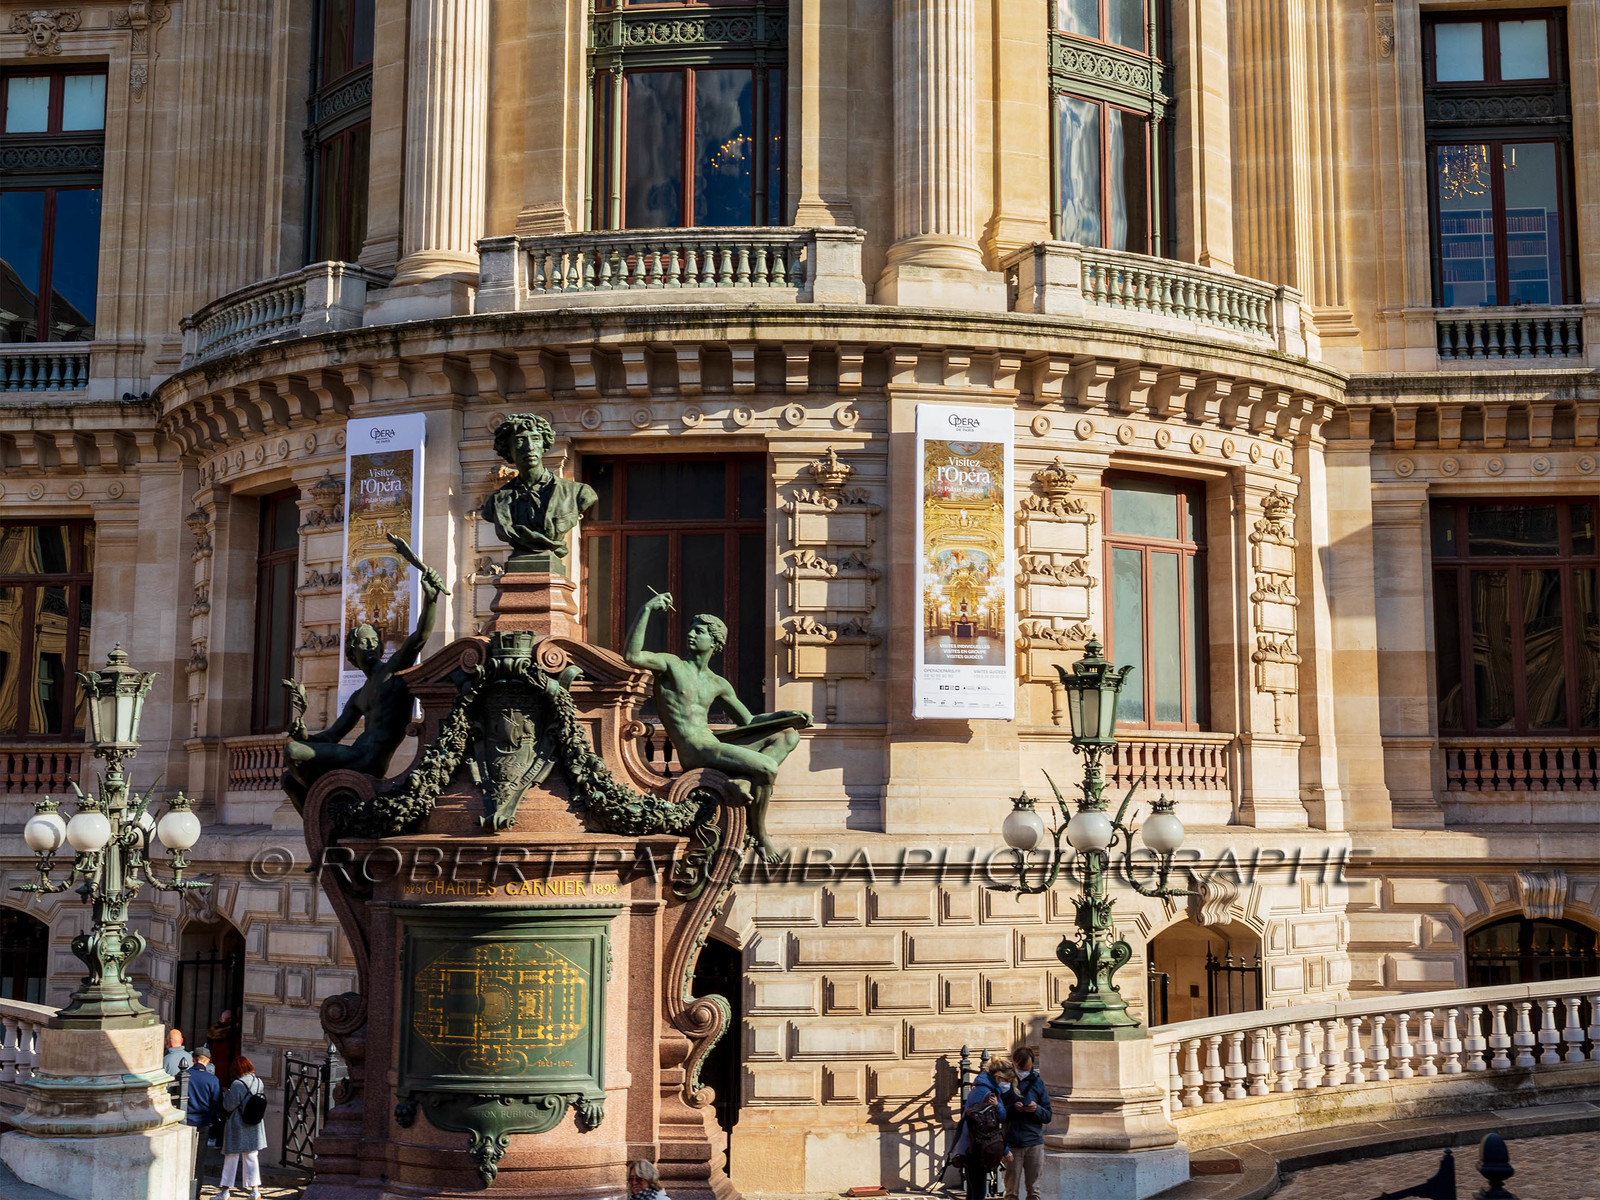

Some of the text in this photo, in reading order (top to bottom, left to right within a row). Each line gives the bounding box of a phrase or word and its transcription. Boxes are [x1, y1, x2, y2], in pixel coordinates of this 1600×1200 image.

[948, 456, 981, 467] Visitez
[369, 468, 395, 478] Visitez
[425, 880, 497, 896] CHARLES
[505, 880, 587, 896] GARNIER
[592, 883, 618, 896] 1898
